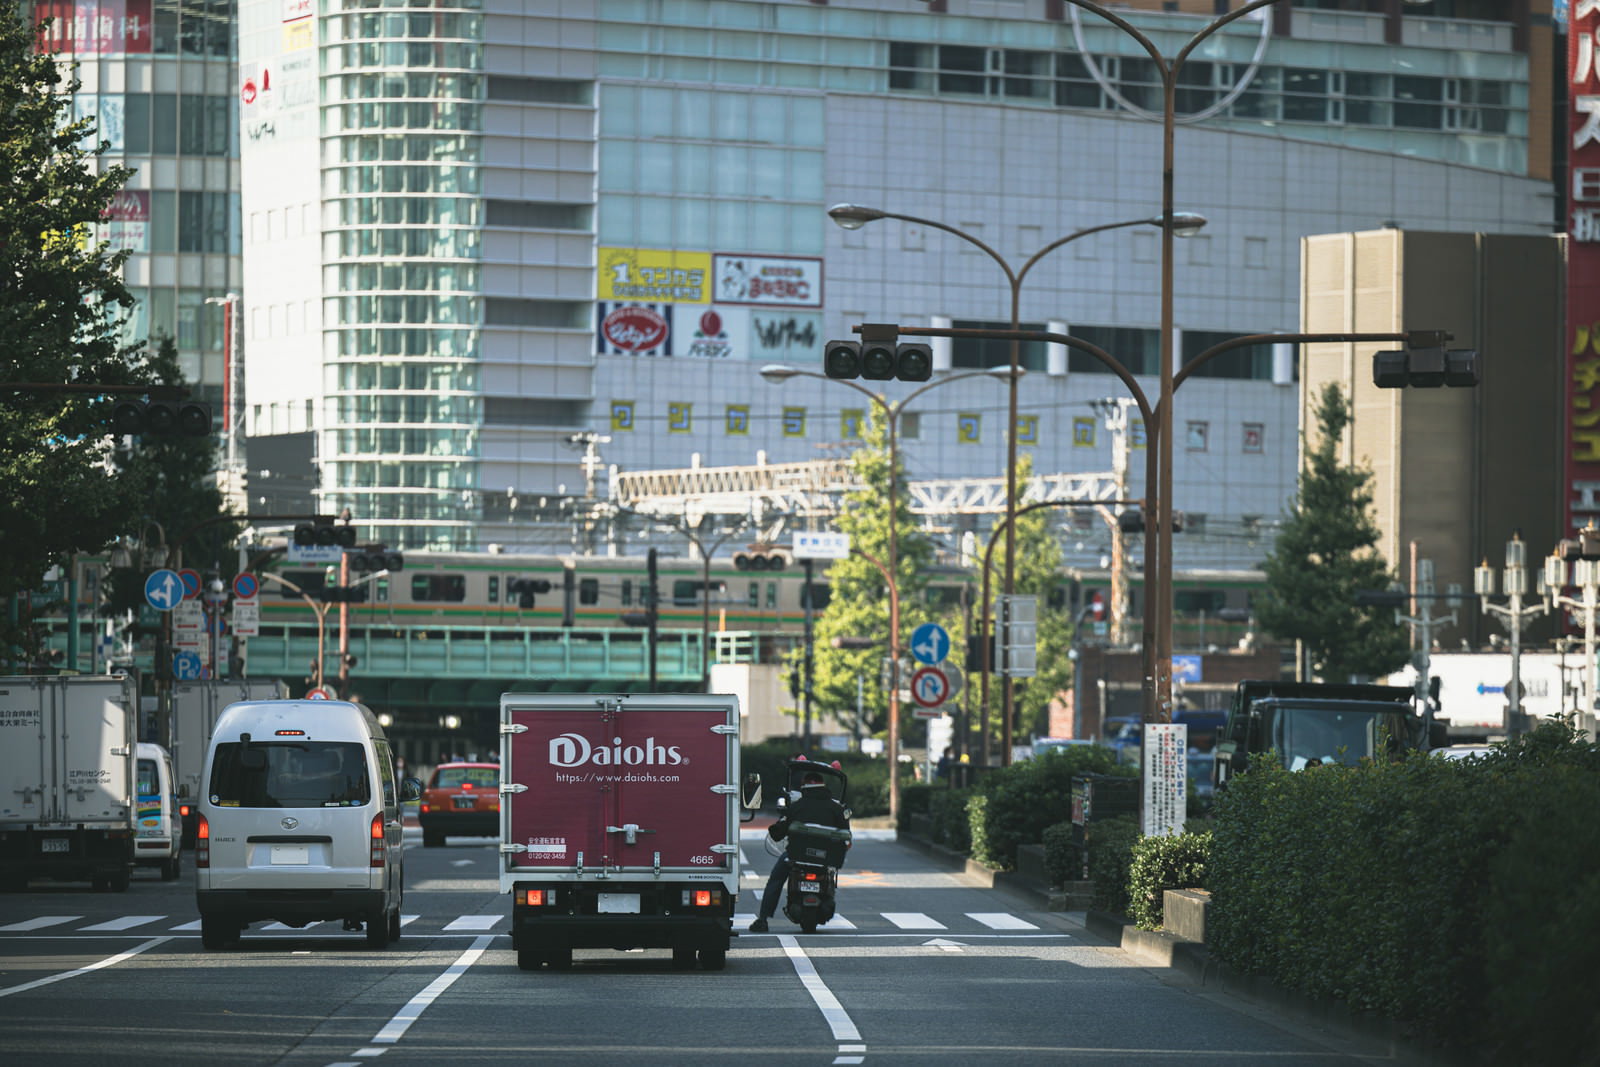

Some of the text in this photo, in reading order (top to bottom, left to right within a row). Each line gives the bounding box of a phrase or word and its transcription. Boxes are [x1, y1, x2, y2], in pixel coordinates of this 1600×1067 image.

[549, 733, 682, 767] Daiohs
[556, 772, 680, 784] https://www.daiohs.com
[690, 855, 714, 864] 4665
